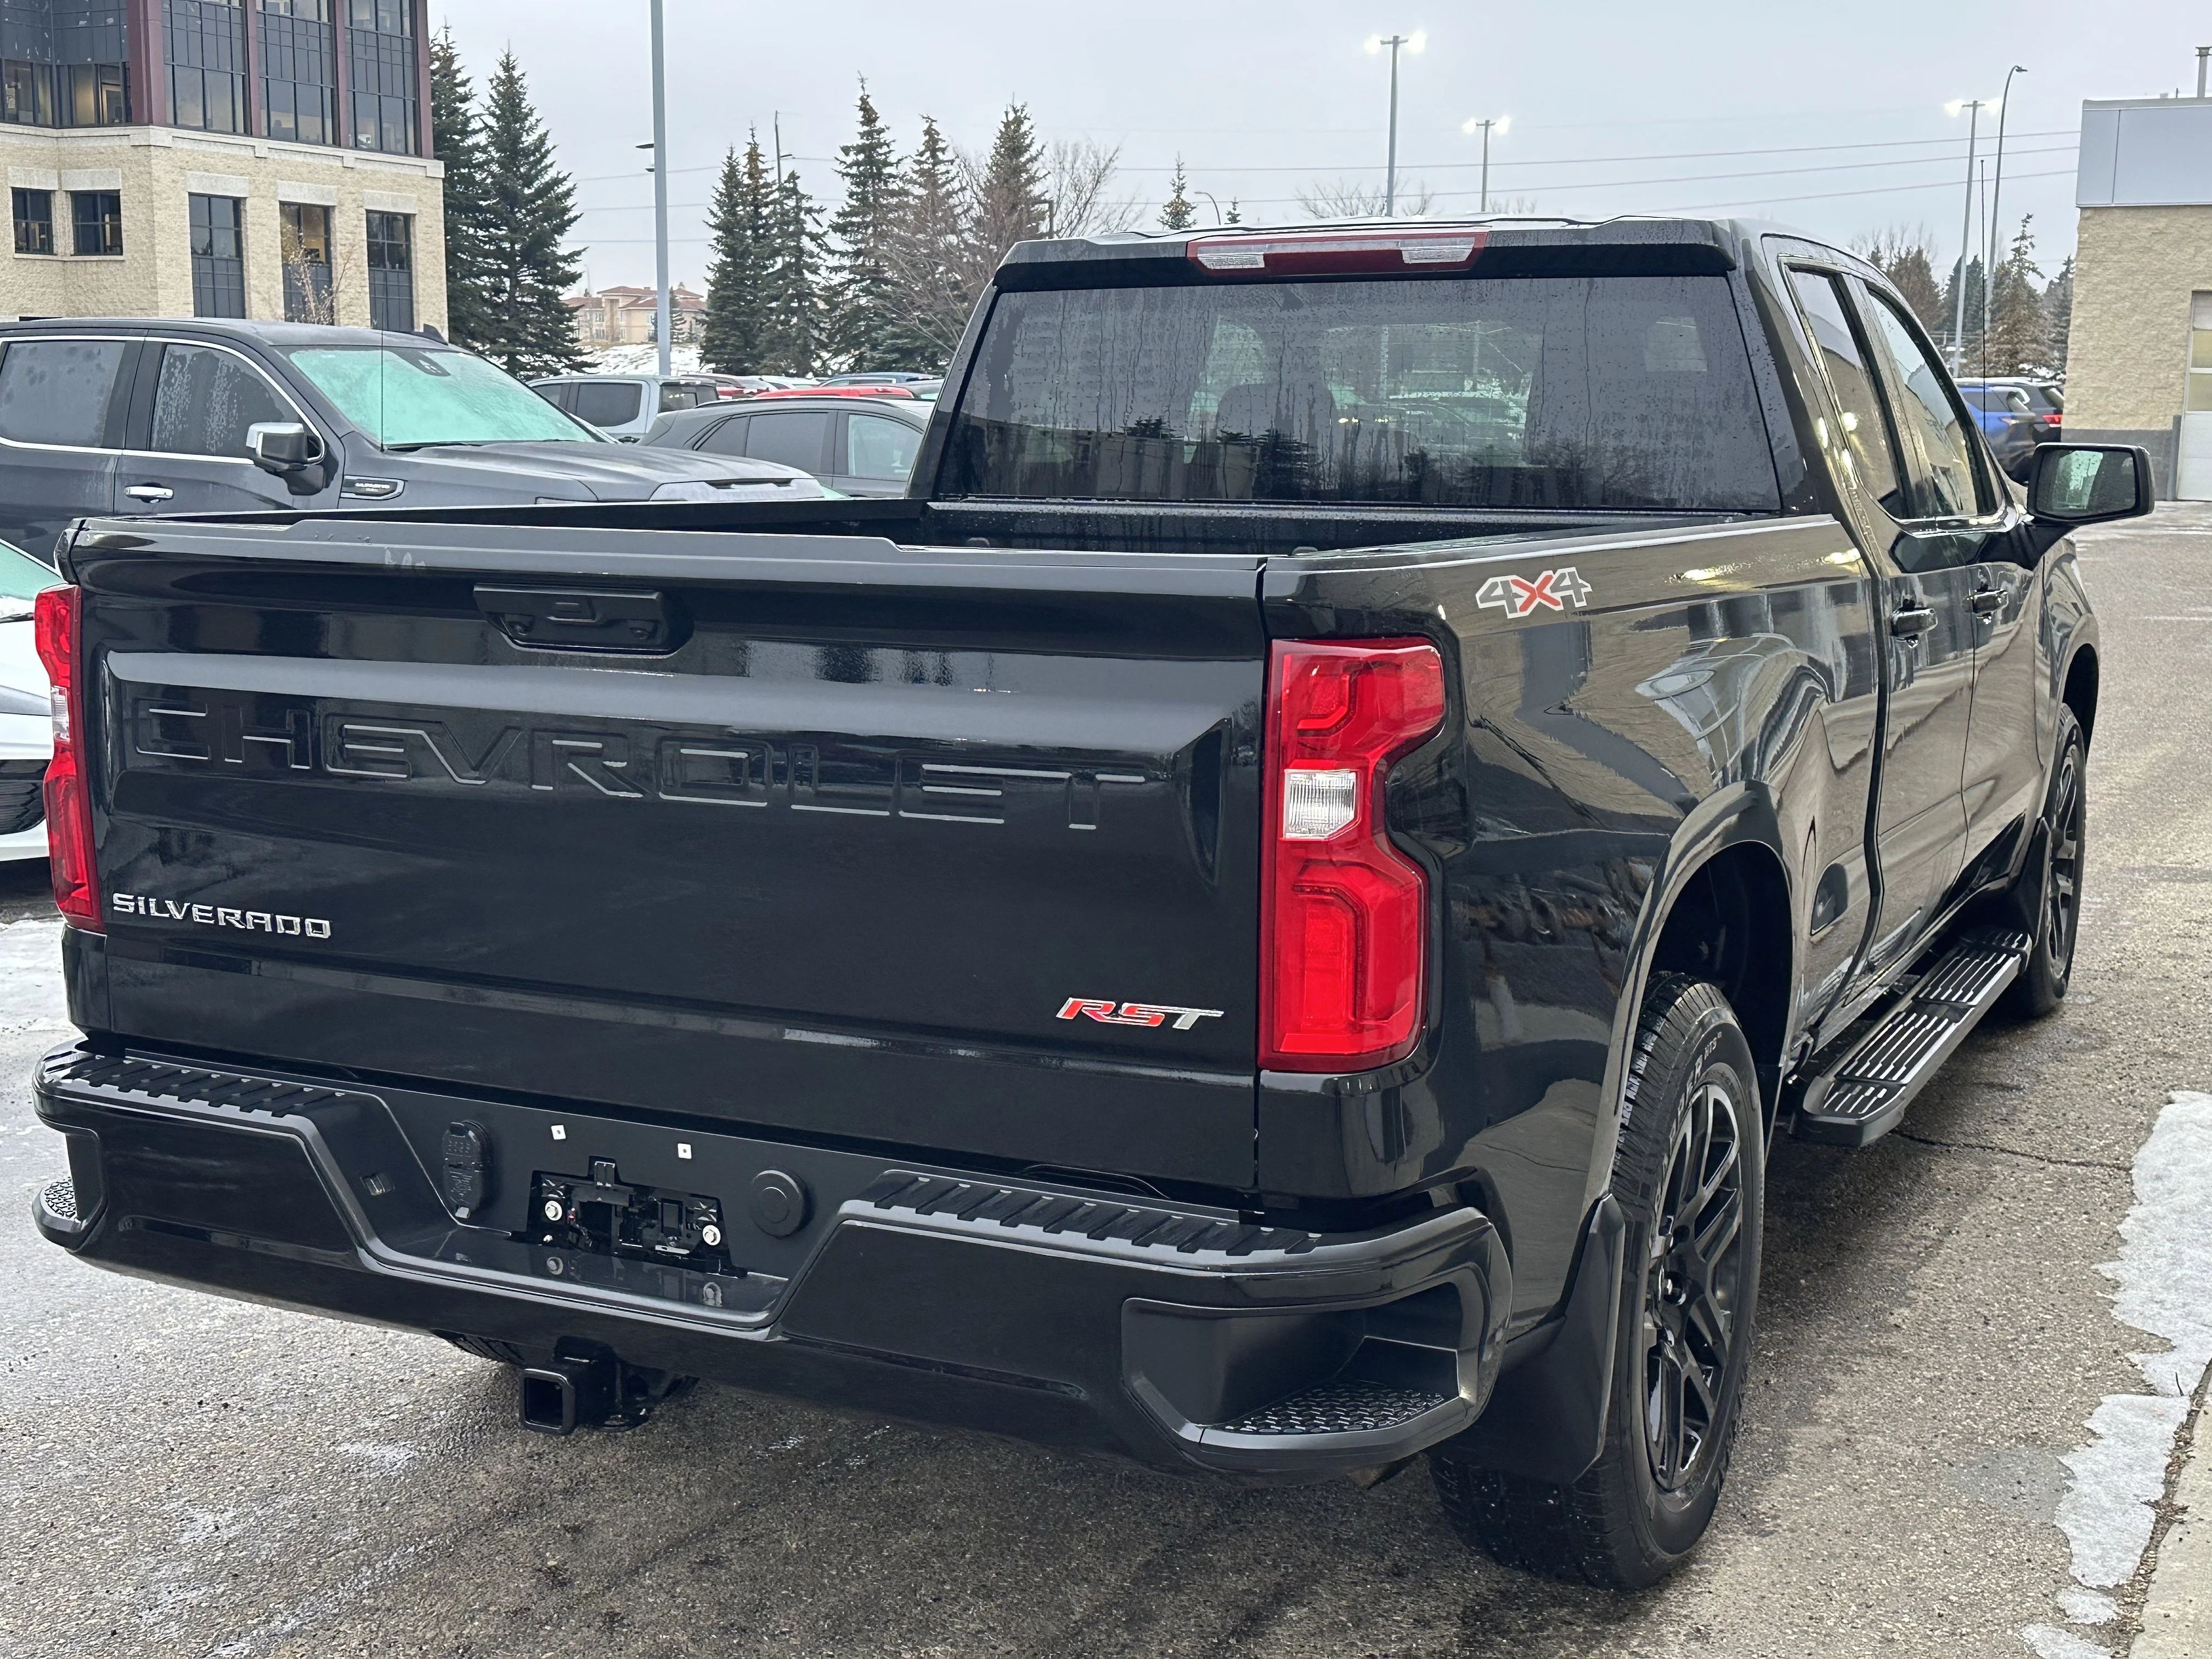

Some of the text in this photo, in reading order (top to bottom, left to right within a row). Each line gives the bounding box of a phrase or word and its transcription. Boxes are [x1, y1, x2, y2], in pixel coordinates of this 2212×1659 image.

[1475, 567, 1593, 619] 4X4
[133, 698, 1147, 830] CHEVROLET
[112, 893, 331, 939] SILVERADO
[1056, 997, 1224, 1030] RST
